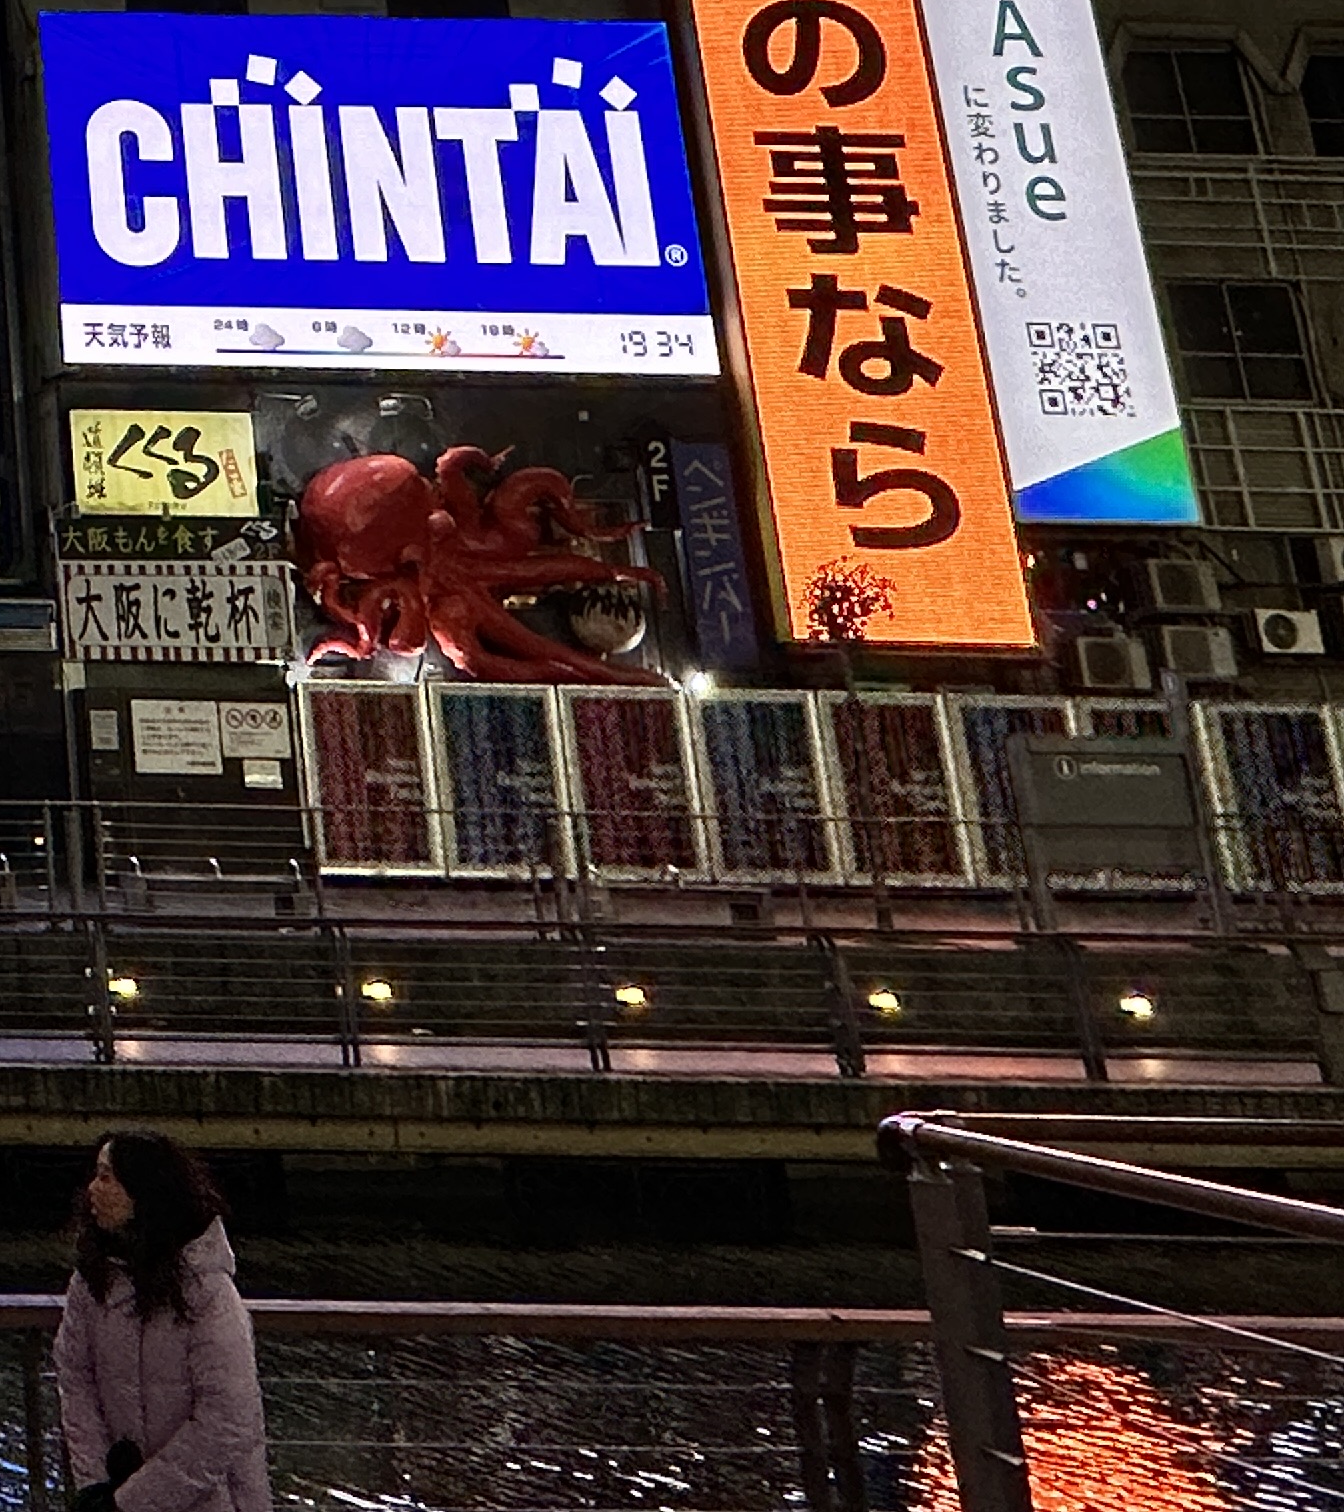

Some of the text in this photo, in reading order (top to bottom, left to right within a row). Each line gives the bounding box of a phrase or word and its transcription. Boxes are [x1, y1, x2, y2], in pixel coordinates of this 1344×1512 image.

[991, 0, 1068, 222] Asue
[962, 84, 1027, 299] に変わりました。
[82, 321, 174, 350] 天気予報
[107, 422, 220, 501] くくる
[62, 523, 219, 555] 大阪もんを食す
[75, 577, 261, 646] 大阪に乾杯
